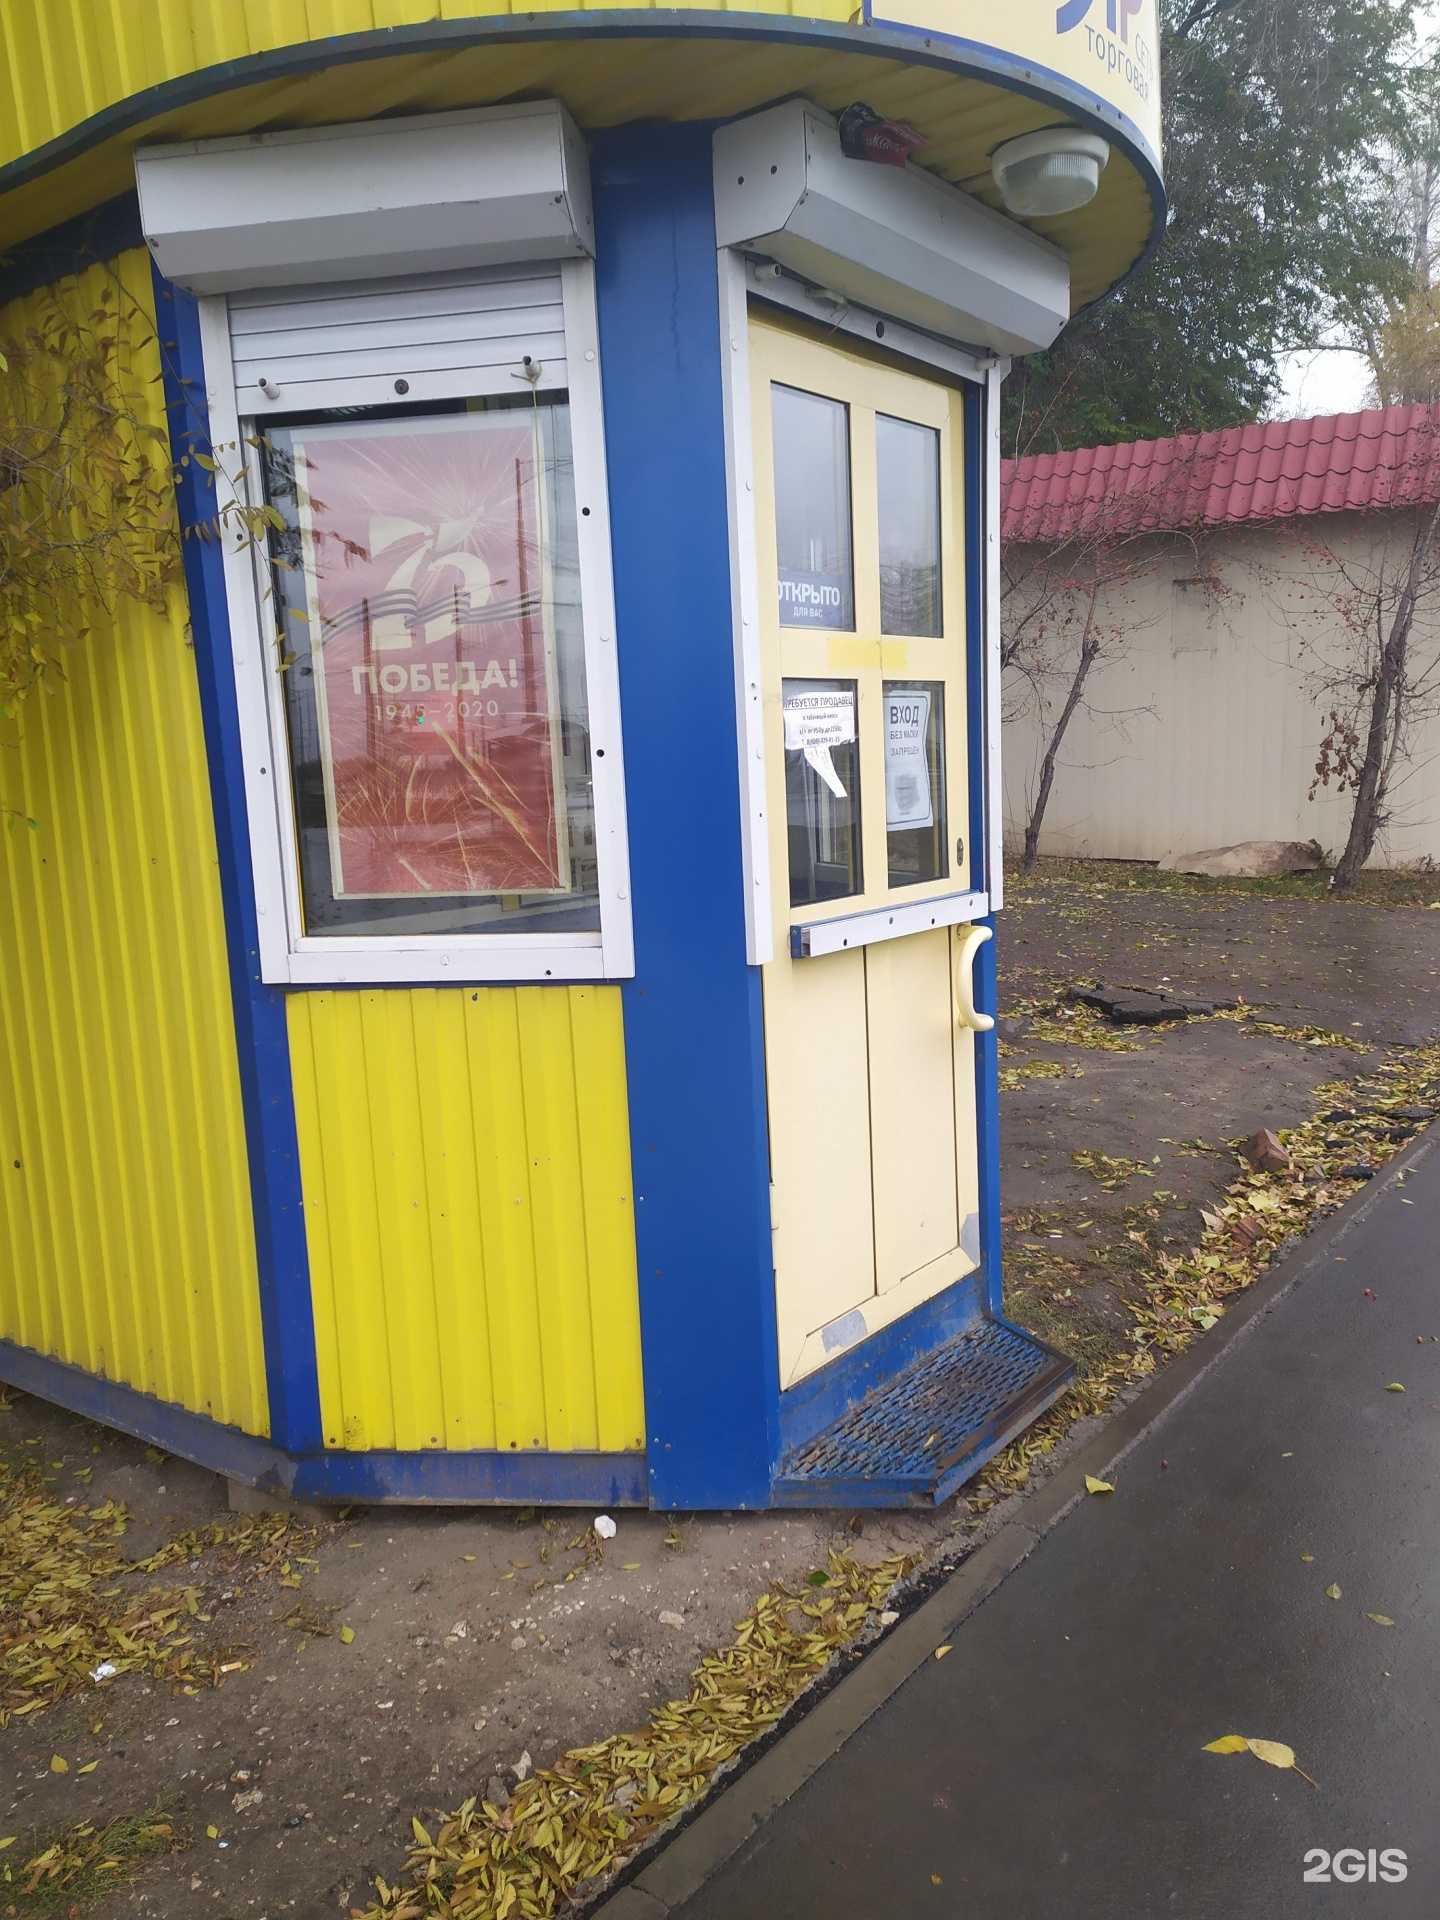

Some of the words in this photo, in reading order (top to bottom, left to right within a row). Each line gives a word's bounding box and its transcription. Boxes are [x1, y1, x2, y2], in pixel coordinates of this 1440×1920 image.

[793, 606, 808, 617] ДЛЯ
[809, 607, 823, 618] ВАС
[351, 658, 519, 697] ПОБЕДА!
[820, 695, 853, 706] ПРОДАВЕЦ
[890, 705, 919, 727] ВХОД
[890, 730, 903, 740] БЕЗ
